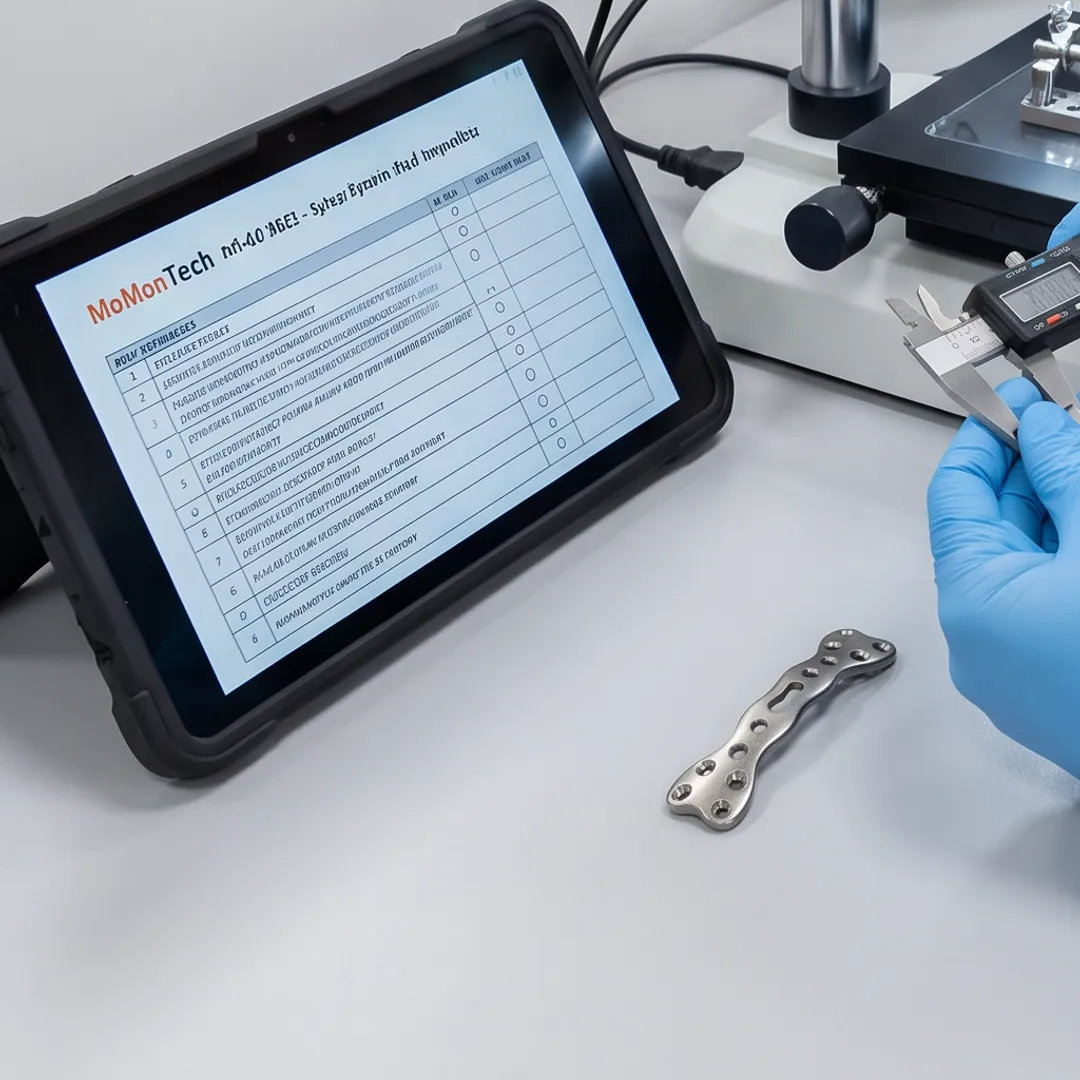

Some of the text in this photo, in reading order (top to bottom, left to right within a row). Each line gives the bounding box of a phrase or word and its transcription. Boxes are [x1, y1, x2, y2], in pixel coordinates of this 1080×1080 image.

[86, 250, 215, 325] MoMonTech
[127, 370, 138, 382] 1
[137, 391, 147, 404] 2
[214, 555, 222, 567] 7
